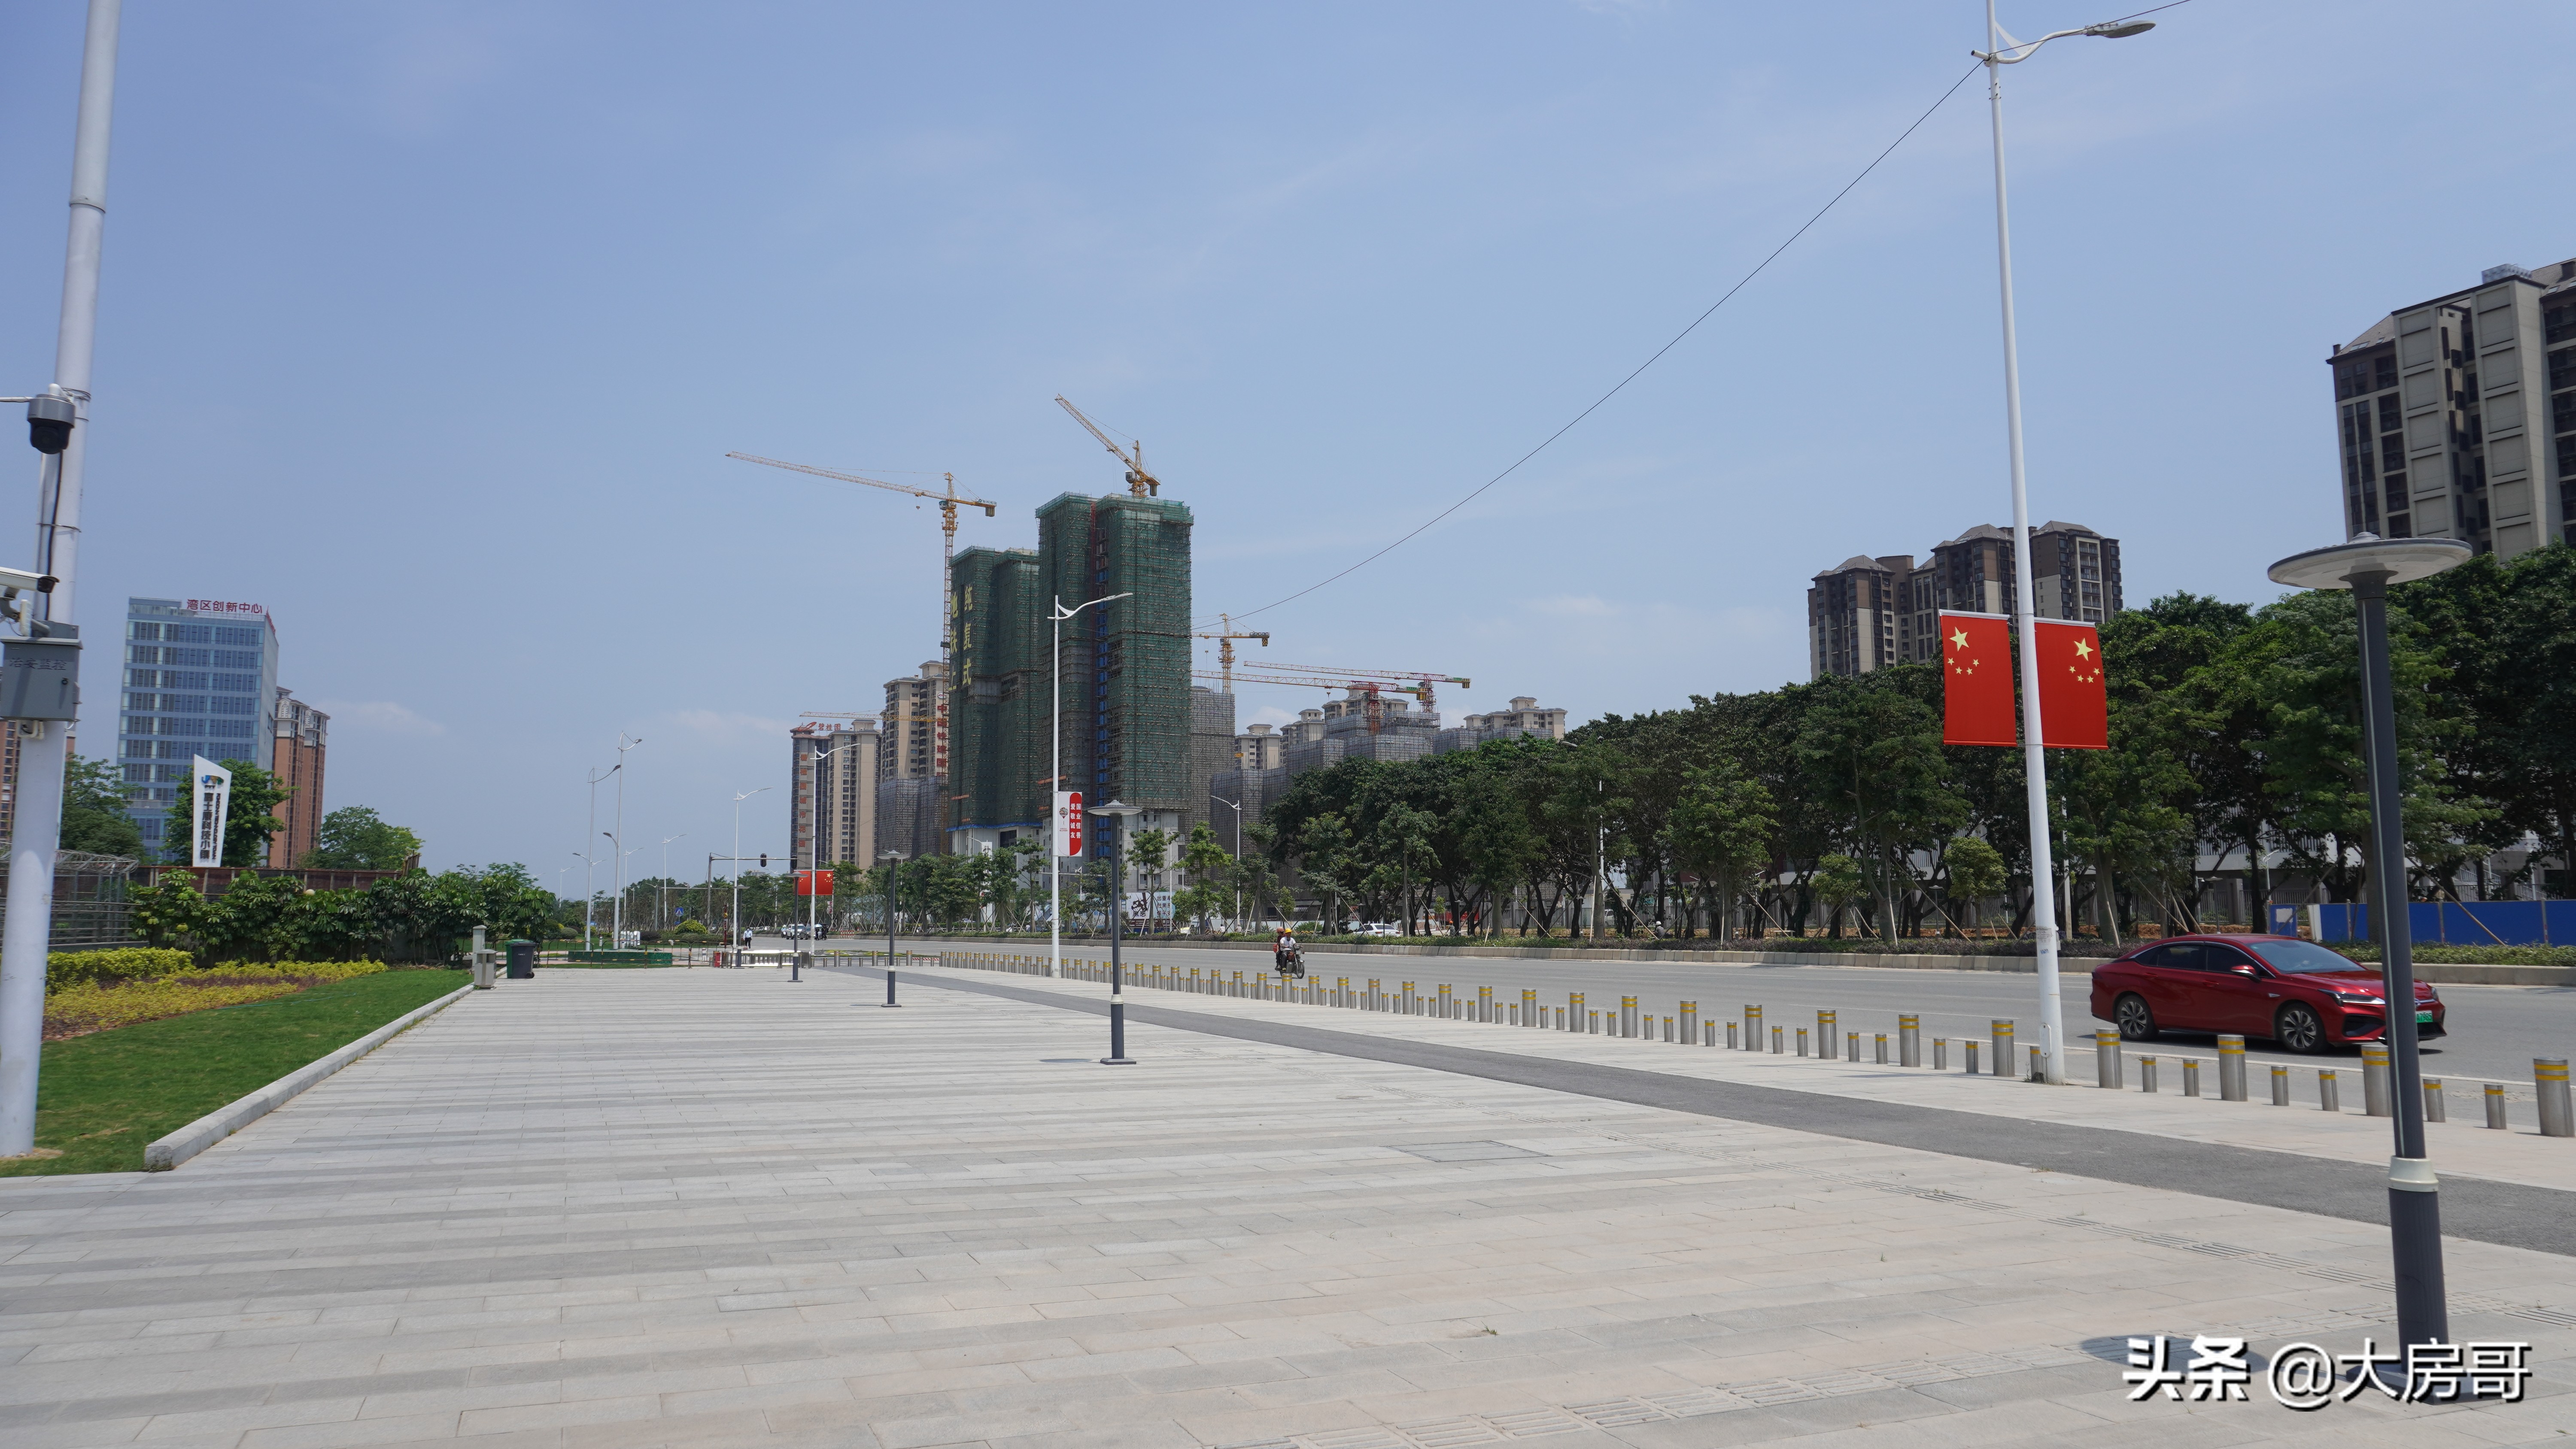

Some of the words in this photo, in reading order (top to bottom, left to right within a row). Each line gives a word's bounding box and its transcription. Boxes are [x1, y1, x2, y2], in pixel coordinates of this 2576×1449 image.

[186, 599, 263, 614] 湾区创新中心
[9, 658, 67, 670] 治安监控
